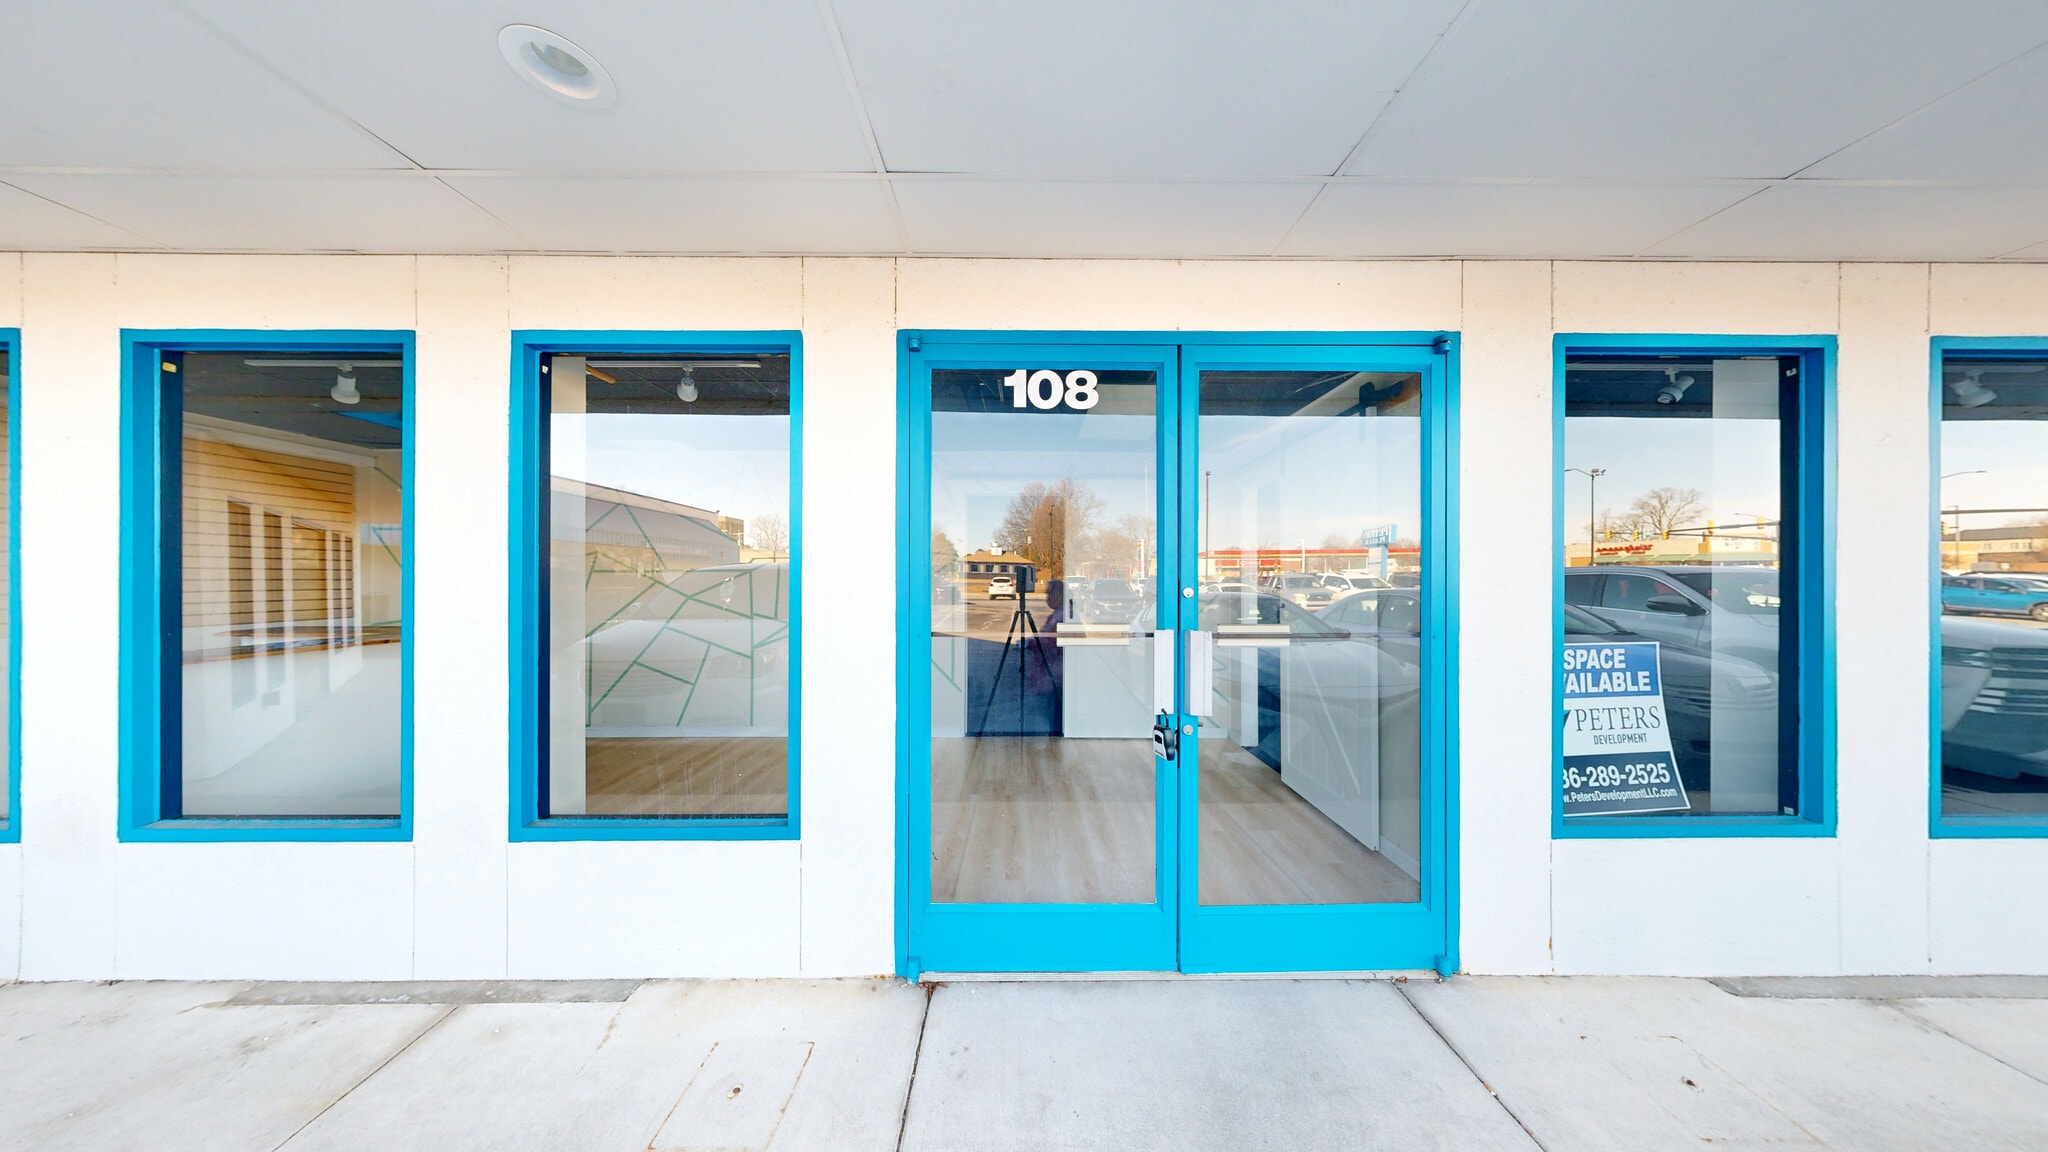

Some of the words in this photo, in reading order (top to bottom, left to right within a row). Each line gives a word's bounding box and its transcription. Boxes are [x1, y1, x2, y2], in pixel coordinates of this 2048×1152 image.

[1004, 369, 1099, 410] 108
[1563, 649, 1626, 669] SPACE
[1563, 671, 1651, 693] AILABLE
[1575, 706, 1661, 731] PETERS
[1594, 733, 1647, 745] DEVELOPMENT
